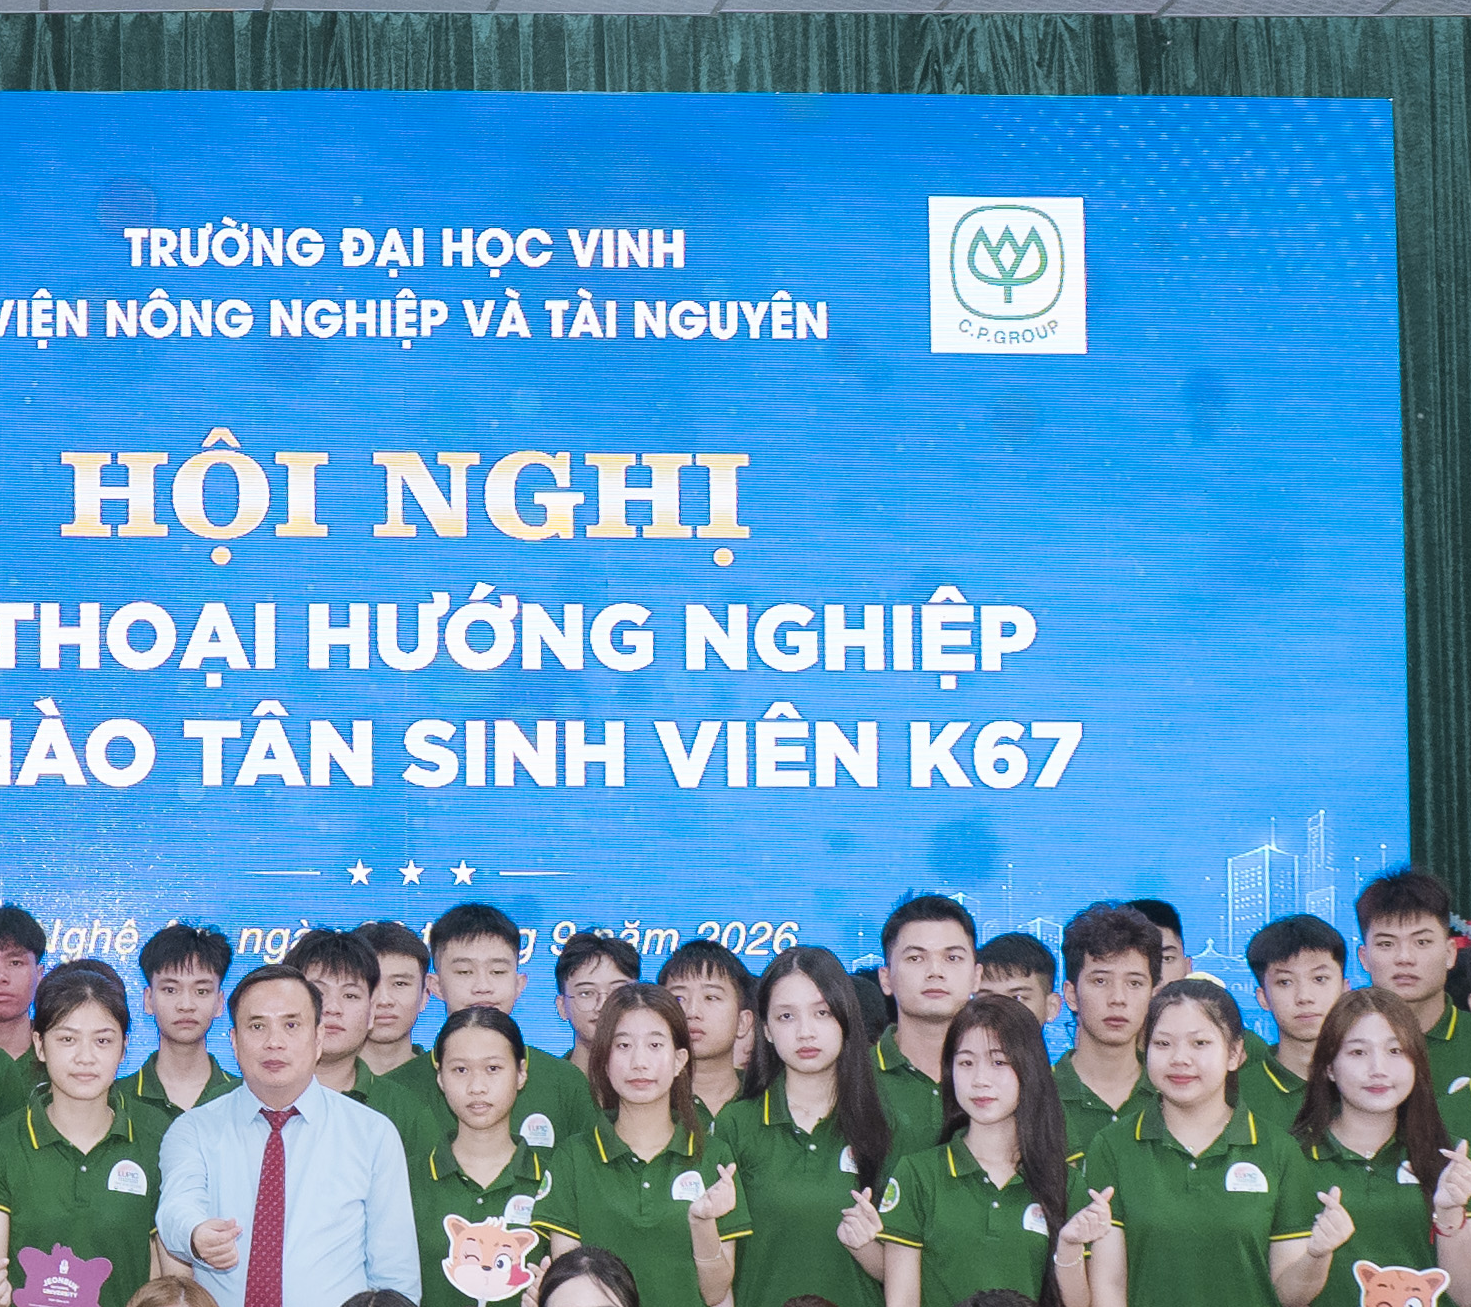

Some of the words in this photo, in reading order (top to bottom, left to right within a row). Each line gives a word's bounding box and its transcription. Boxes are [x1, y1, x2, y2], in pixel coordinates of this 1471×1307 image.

[123, 215, 326, 267] TRƯỜNG
[339, 227, 425, 278] ĐẠI
[442, 227, 554, 278] HỌC
[567, 228, 686, 268] VINH
[105, 285, 254, 339] NÔNG
[269, 287, 449, 350] NGHIỆP
[461, 285, 532, 339] VÀ
[544, 285, 618, 339] TÀI
[633, 285, 829, 341] NGUYÊN
[60, 426, 330, 567] HỘI
[372, 450, 751, 568] NGHỊ
[308, 580, 655, 672] HƯỚNG
[685, 582, 1038, 686] NGHIỆP
[183, 699, 373, 790] TÂN
[401, 718, 626, 789] SINH
[653, 699, 879, 789] VIÊN
[909, 719, 1083, 789] K67
